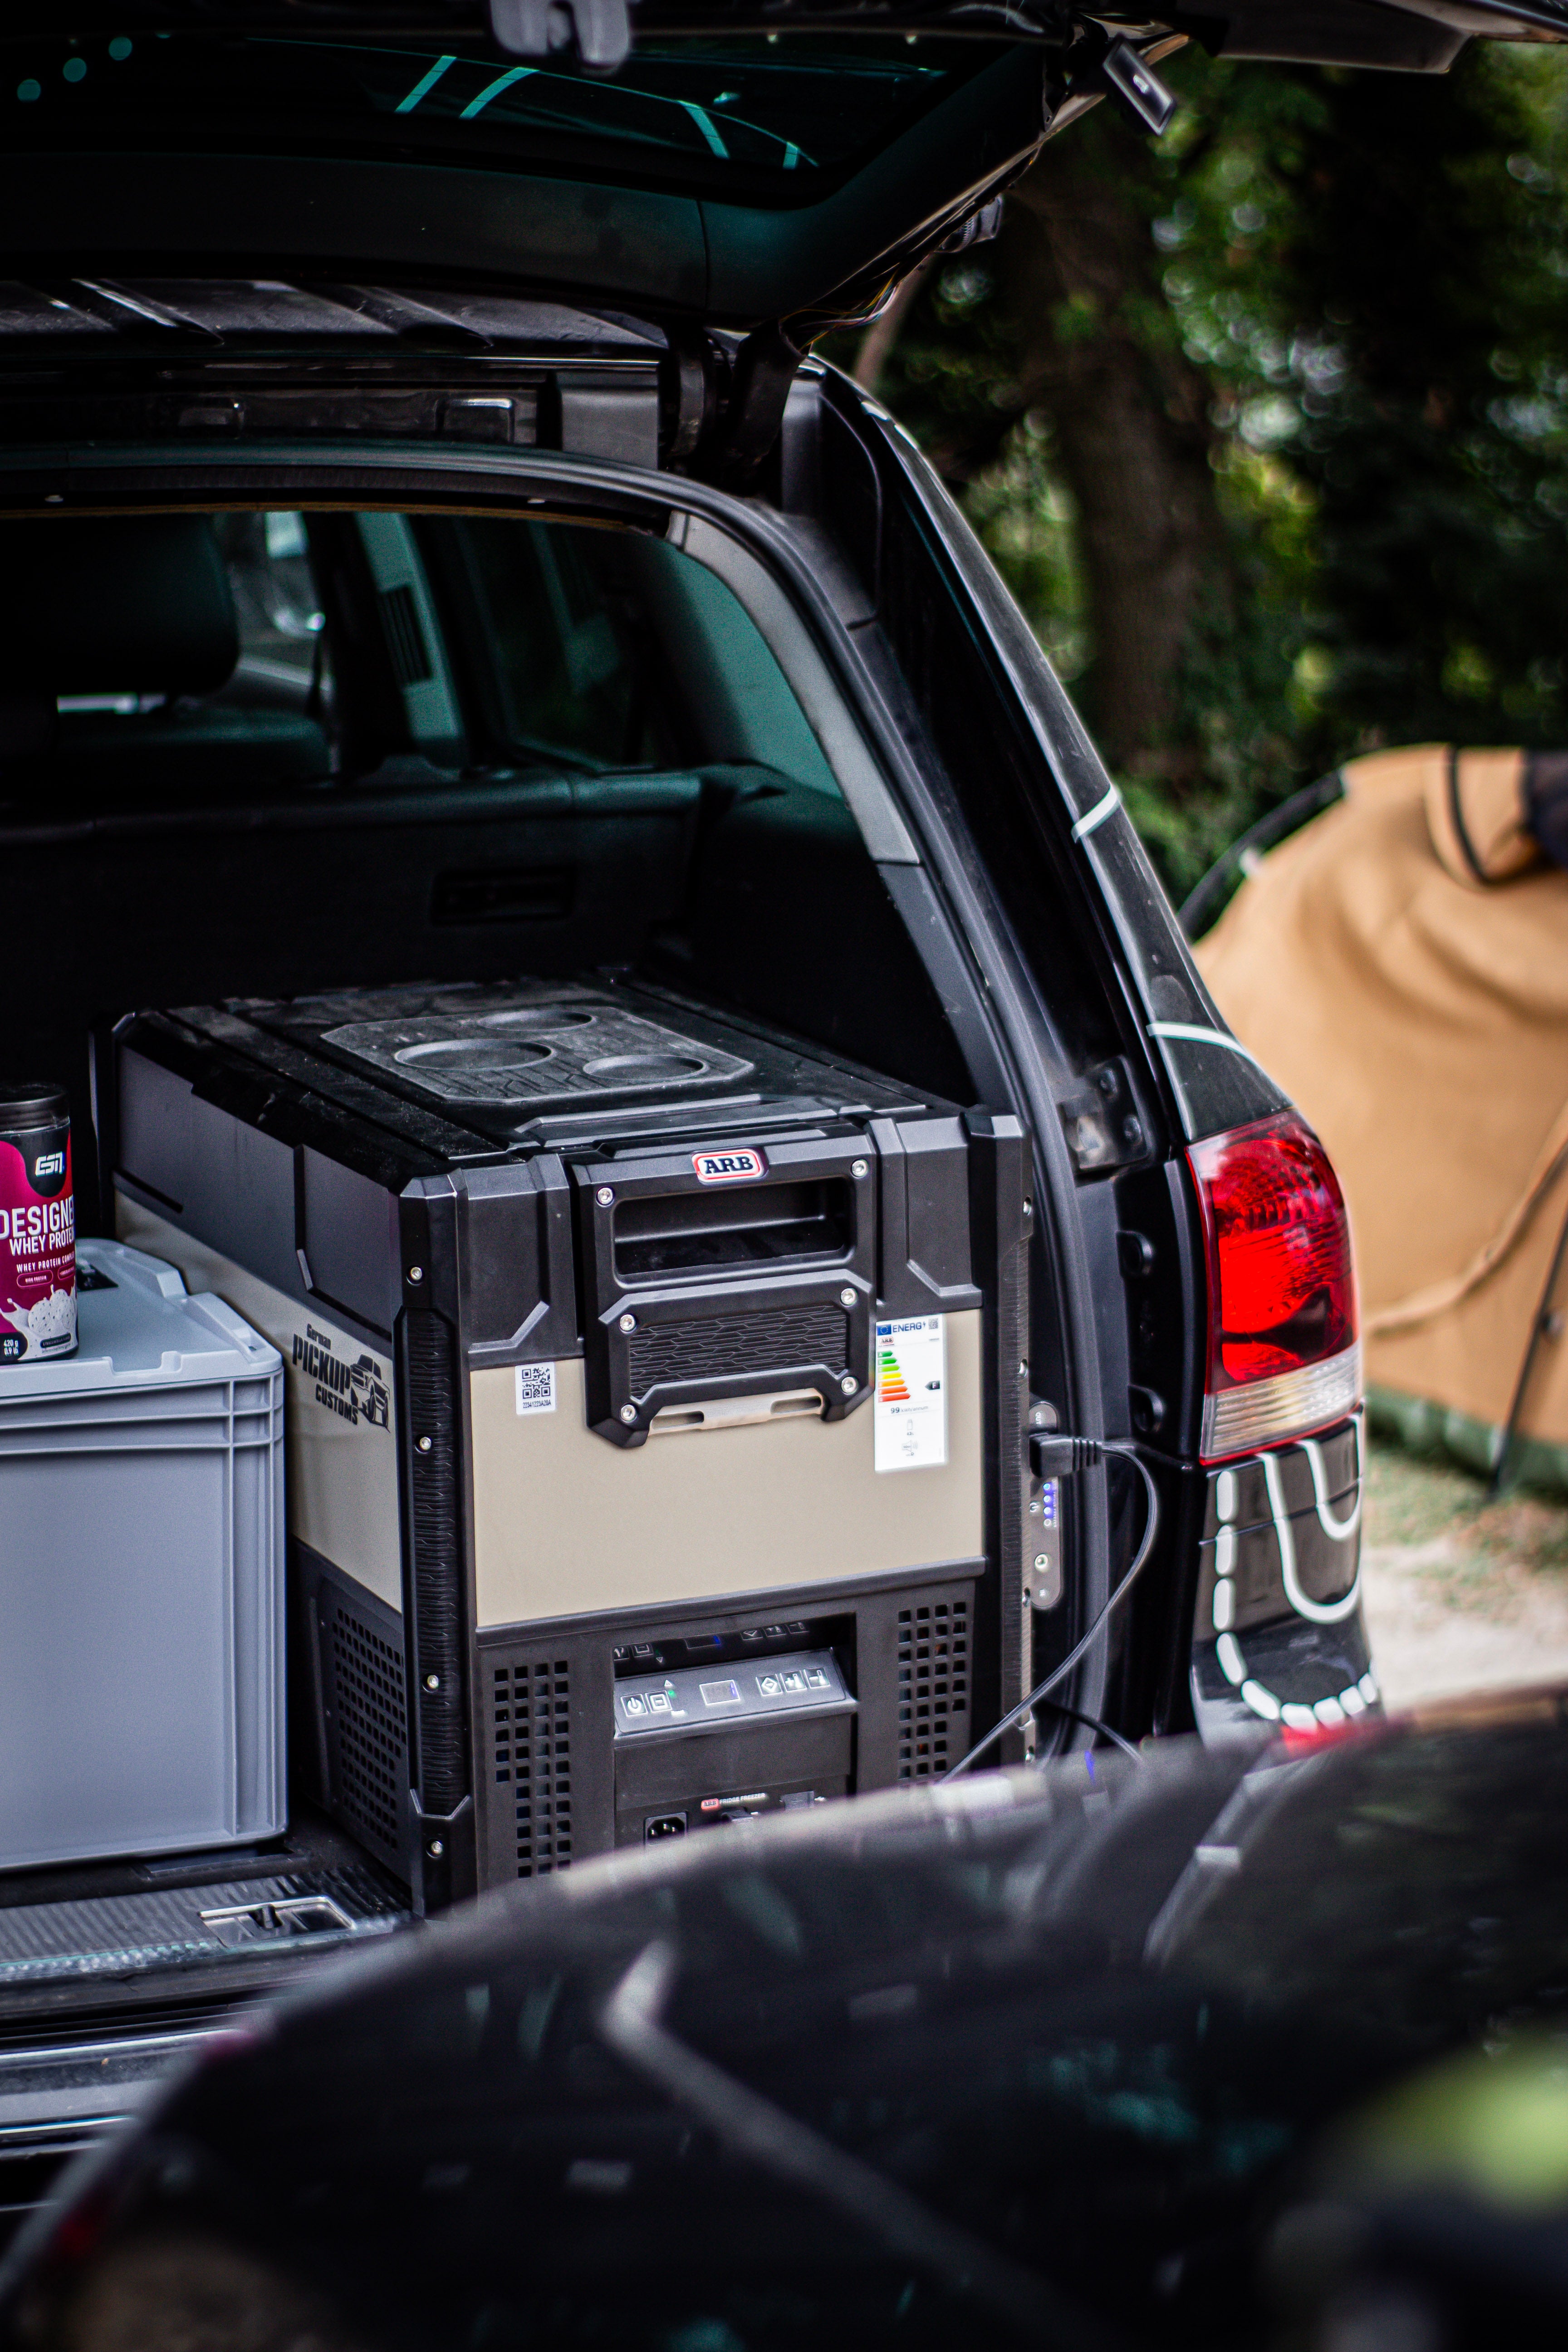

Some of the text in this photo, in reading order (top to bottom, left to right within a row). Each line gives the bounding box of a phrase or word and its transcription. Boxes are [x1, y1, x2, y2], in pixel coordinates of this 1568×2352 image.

[704, 1156, 753, 1174] ARB
[0, 1194, 74, 1240] DESIGNE
[9, 1235, 46, 1256] WHEY
[16, 1261, 36, 1274] WHEY
[38, 1257, 61, 1271] PROTEIN
[307, 1323, 332, 1350] German
[892, 1322, 922, 1333] ENERG
[293, 1333, 352, 1395] PICKUP
[315, 1384, 358, 1425] CUSTOMS
[740, 1793, 765, 1801] FREEZER
